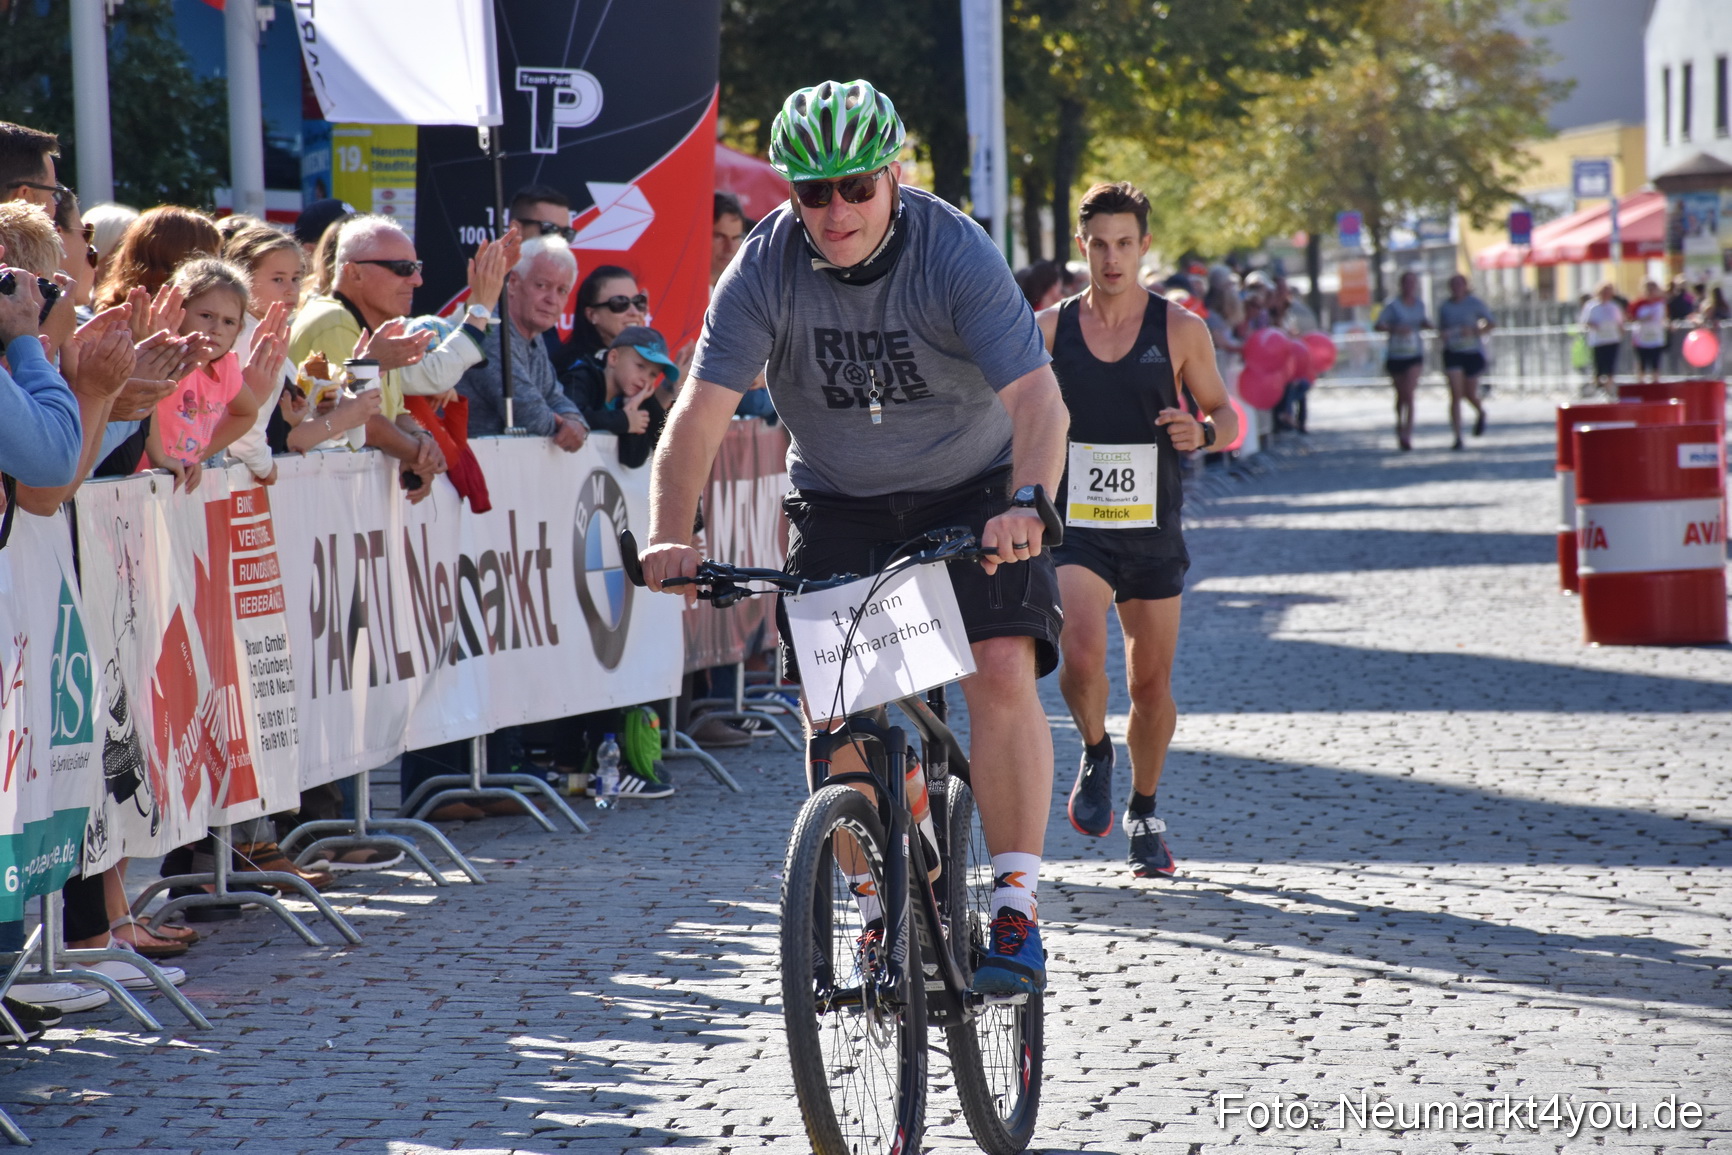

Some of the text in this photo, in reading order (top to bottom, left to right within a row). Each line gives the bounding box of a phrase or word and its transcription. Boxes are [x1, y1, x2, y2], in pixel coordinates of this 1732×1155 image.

[522, 74, 547, 84] Team
[336, 145, 369, 173] 19.
[814, 327, 915, 362] RIDE
[816, 360, 926, 387] YOUR
[821, 381, 935, 409] BIKE
[1093, 452, 1131, 461] BOCK
[1089, 467, 1135, 493] 248
[576, 474, 628, 538] BMW
[1093, 507, 1130, 519] Patrick
[309, 530, 415, 699] PARTL
[265, 633, 287, 653] GmbH
[814, 617, 942, 666] Halbmarathon
[258, 656, 289, 676] Grünberg
